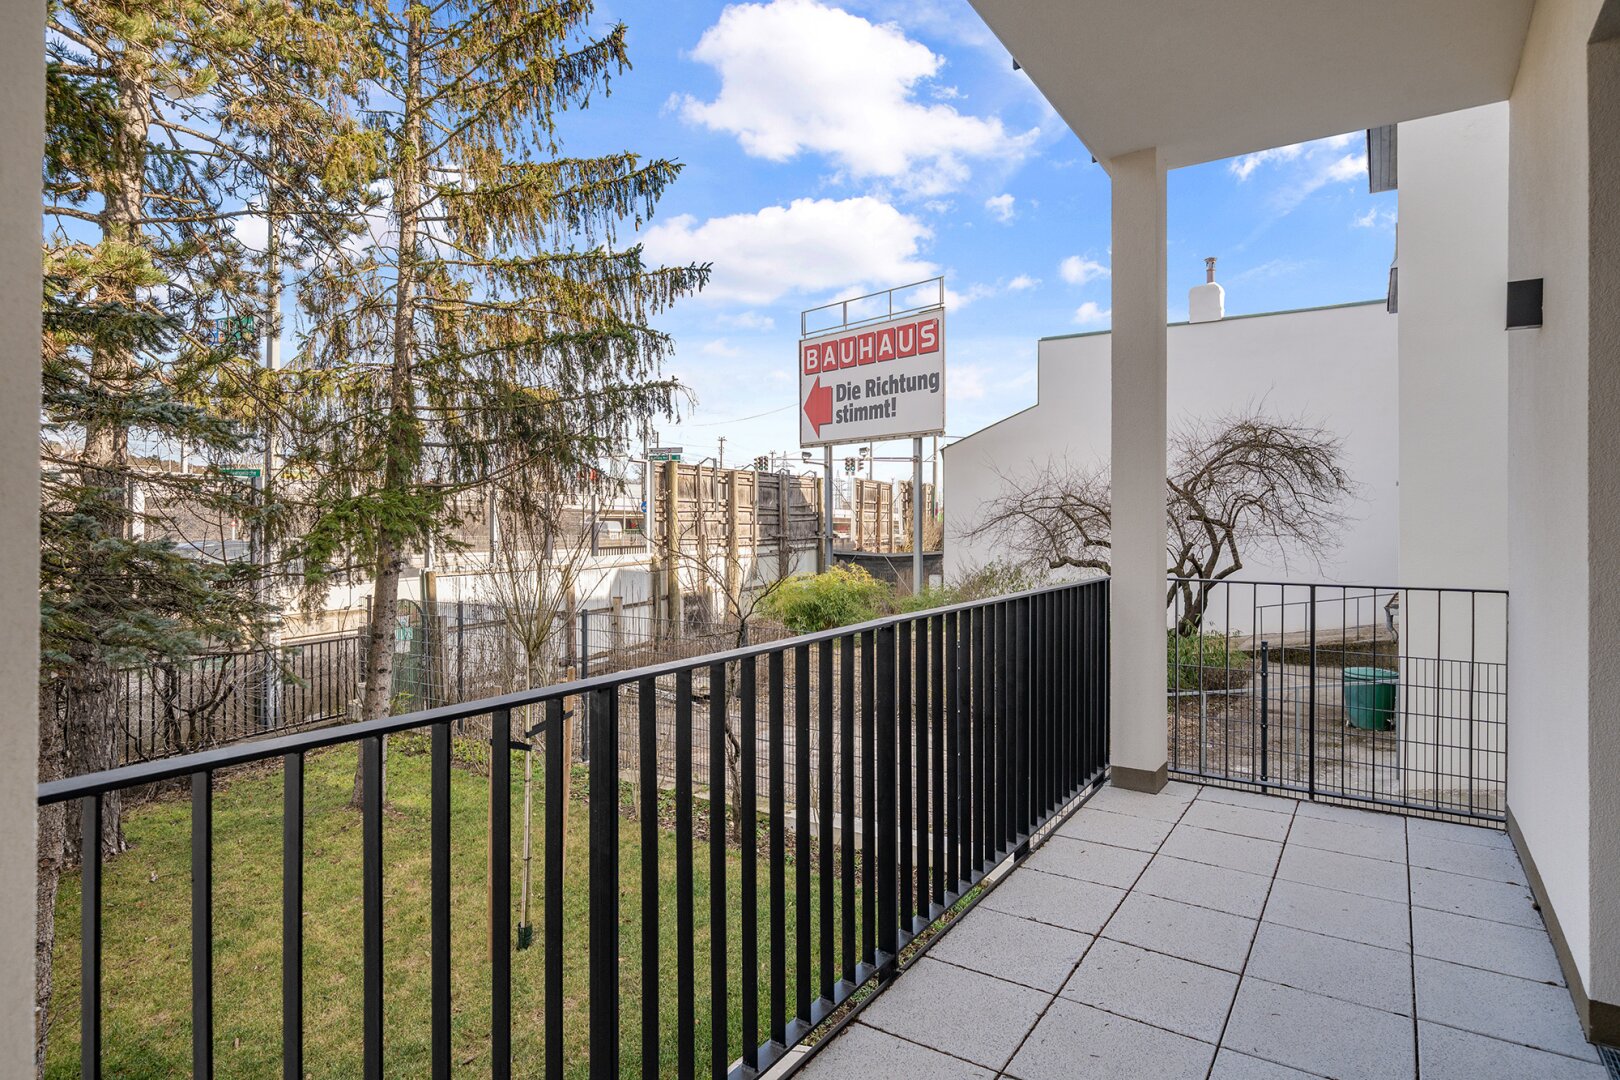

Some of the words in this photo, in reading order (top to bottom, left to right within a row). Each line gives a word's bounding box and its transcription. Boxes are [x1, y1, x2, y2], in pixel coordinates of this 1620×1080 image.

[805, 323, 937, 370] BAUHAUS
[836, 382, 861, 402] Die
[865, 372, 940, 398] Richtung
[835, 397, 897, 424] stimmt!
